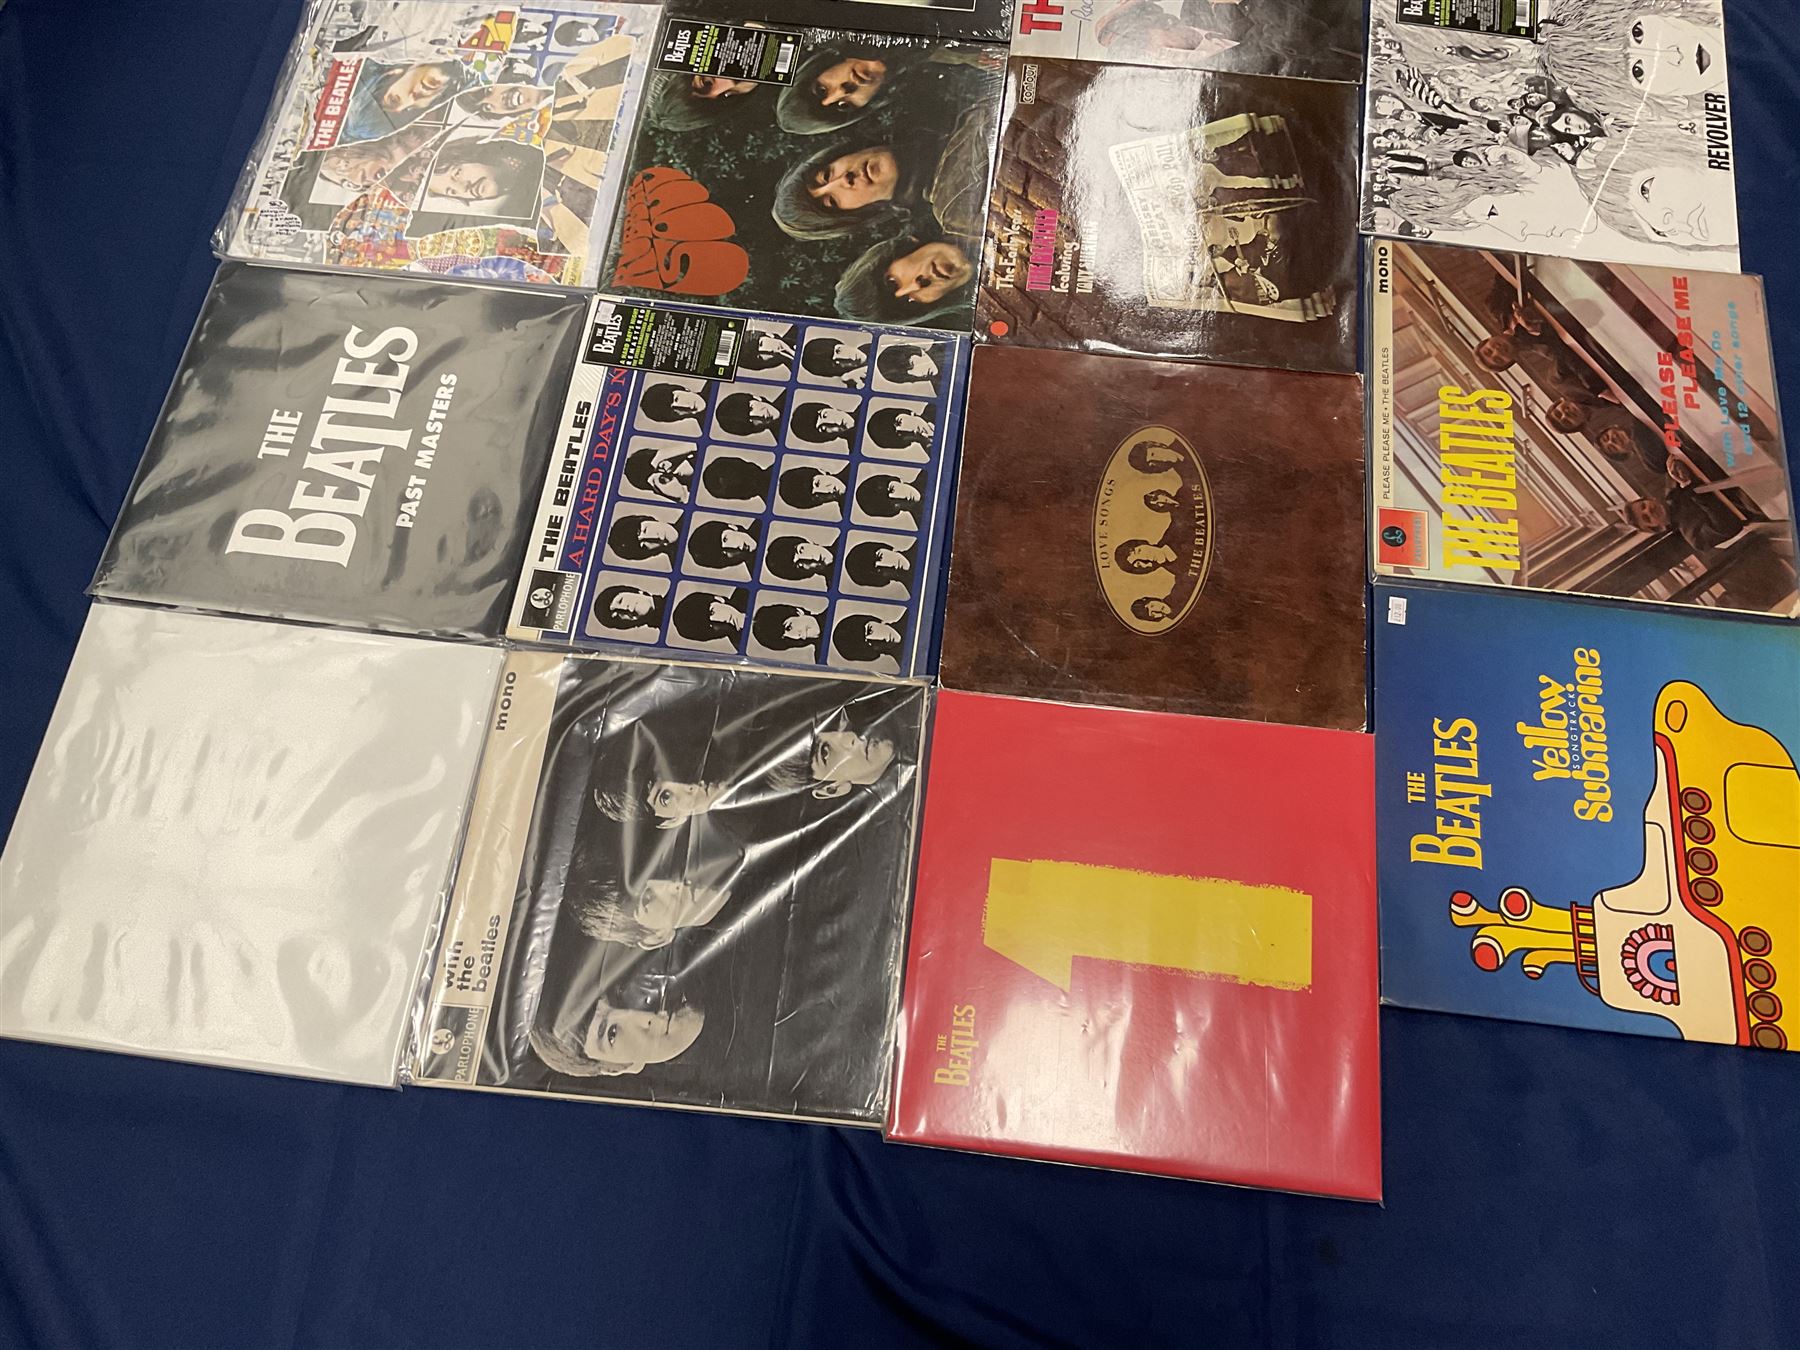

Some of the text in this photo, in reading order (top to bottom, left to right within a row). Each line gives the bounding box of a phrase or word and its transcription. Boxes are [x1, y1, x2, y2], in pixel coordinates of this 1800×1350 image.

[664, 30, 691, 63] BEATLES
[1020, 65, 1037, 103] contour
[314, 56, 361, 147] THE BEATLES
[1706, 93, 1730, 171] REVOLVER
[996, 209, 1026, 290] The Early Years
[1026, 208, 1058, 291] THE BEATLES
[1051, 241, 1080, 293] featuring
[1076, 270, 1093, 293] TONY
[1378, 247, 1388, 294] mono
[592, 314, 622, 353] BEATLES
[626, 309, 645, 365] REMASTERED
[1672, 276, 1701, 410] PLEASE ME
[257, 408, 303, 459] THE
[593, 388, 622, 463] DAY'S
[1380, 347, 1391, 499] PLEASE PLEASE ME THE BEATLES
[1657, 351, 1682, 448] PLEASE
[1717, 386, 1730, 425] Love
[1736, 401, 1749, 419] 12
[225, 325, 419, 569] BEATLES
[396, 373, 457, 528] PAST MASTERS
[539, 400, 592, 562] THE BEATLES
[1438, 385, 1521, 571] THE BEATLES
[571, 467, 604, 545] HARD
[1098, 479, 1116, 569] LOVE SONGS
[1188, 484, 1205, 577] THE BEATLES
[568, 550, 583, 568] A
[553, 572, 578, 632] PARLOPHONE
[495, 670, 517, 732] mono
[1516, 674, 1572, 782] Yellow
[1569, 693, 1580, 770] SONGTRACK
[1572, 647, 1613, 823] Submarine
[1407, 771, 1426, 804] THE
[1409, 717, 1492, 871] BEATLES
[472, 914, 501, 993] beatles
[983, 858, 1312, 993] 1
[444, 941, 463, 988] with
[457, 955, 475, 991] the
[454, 1006, 480, 1081] PARLOPHONE
[934, 1004, 976, 1087] BEATLES
[937, 1034, 946, 1052] THE
